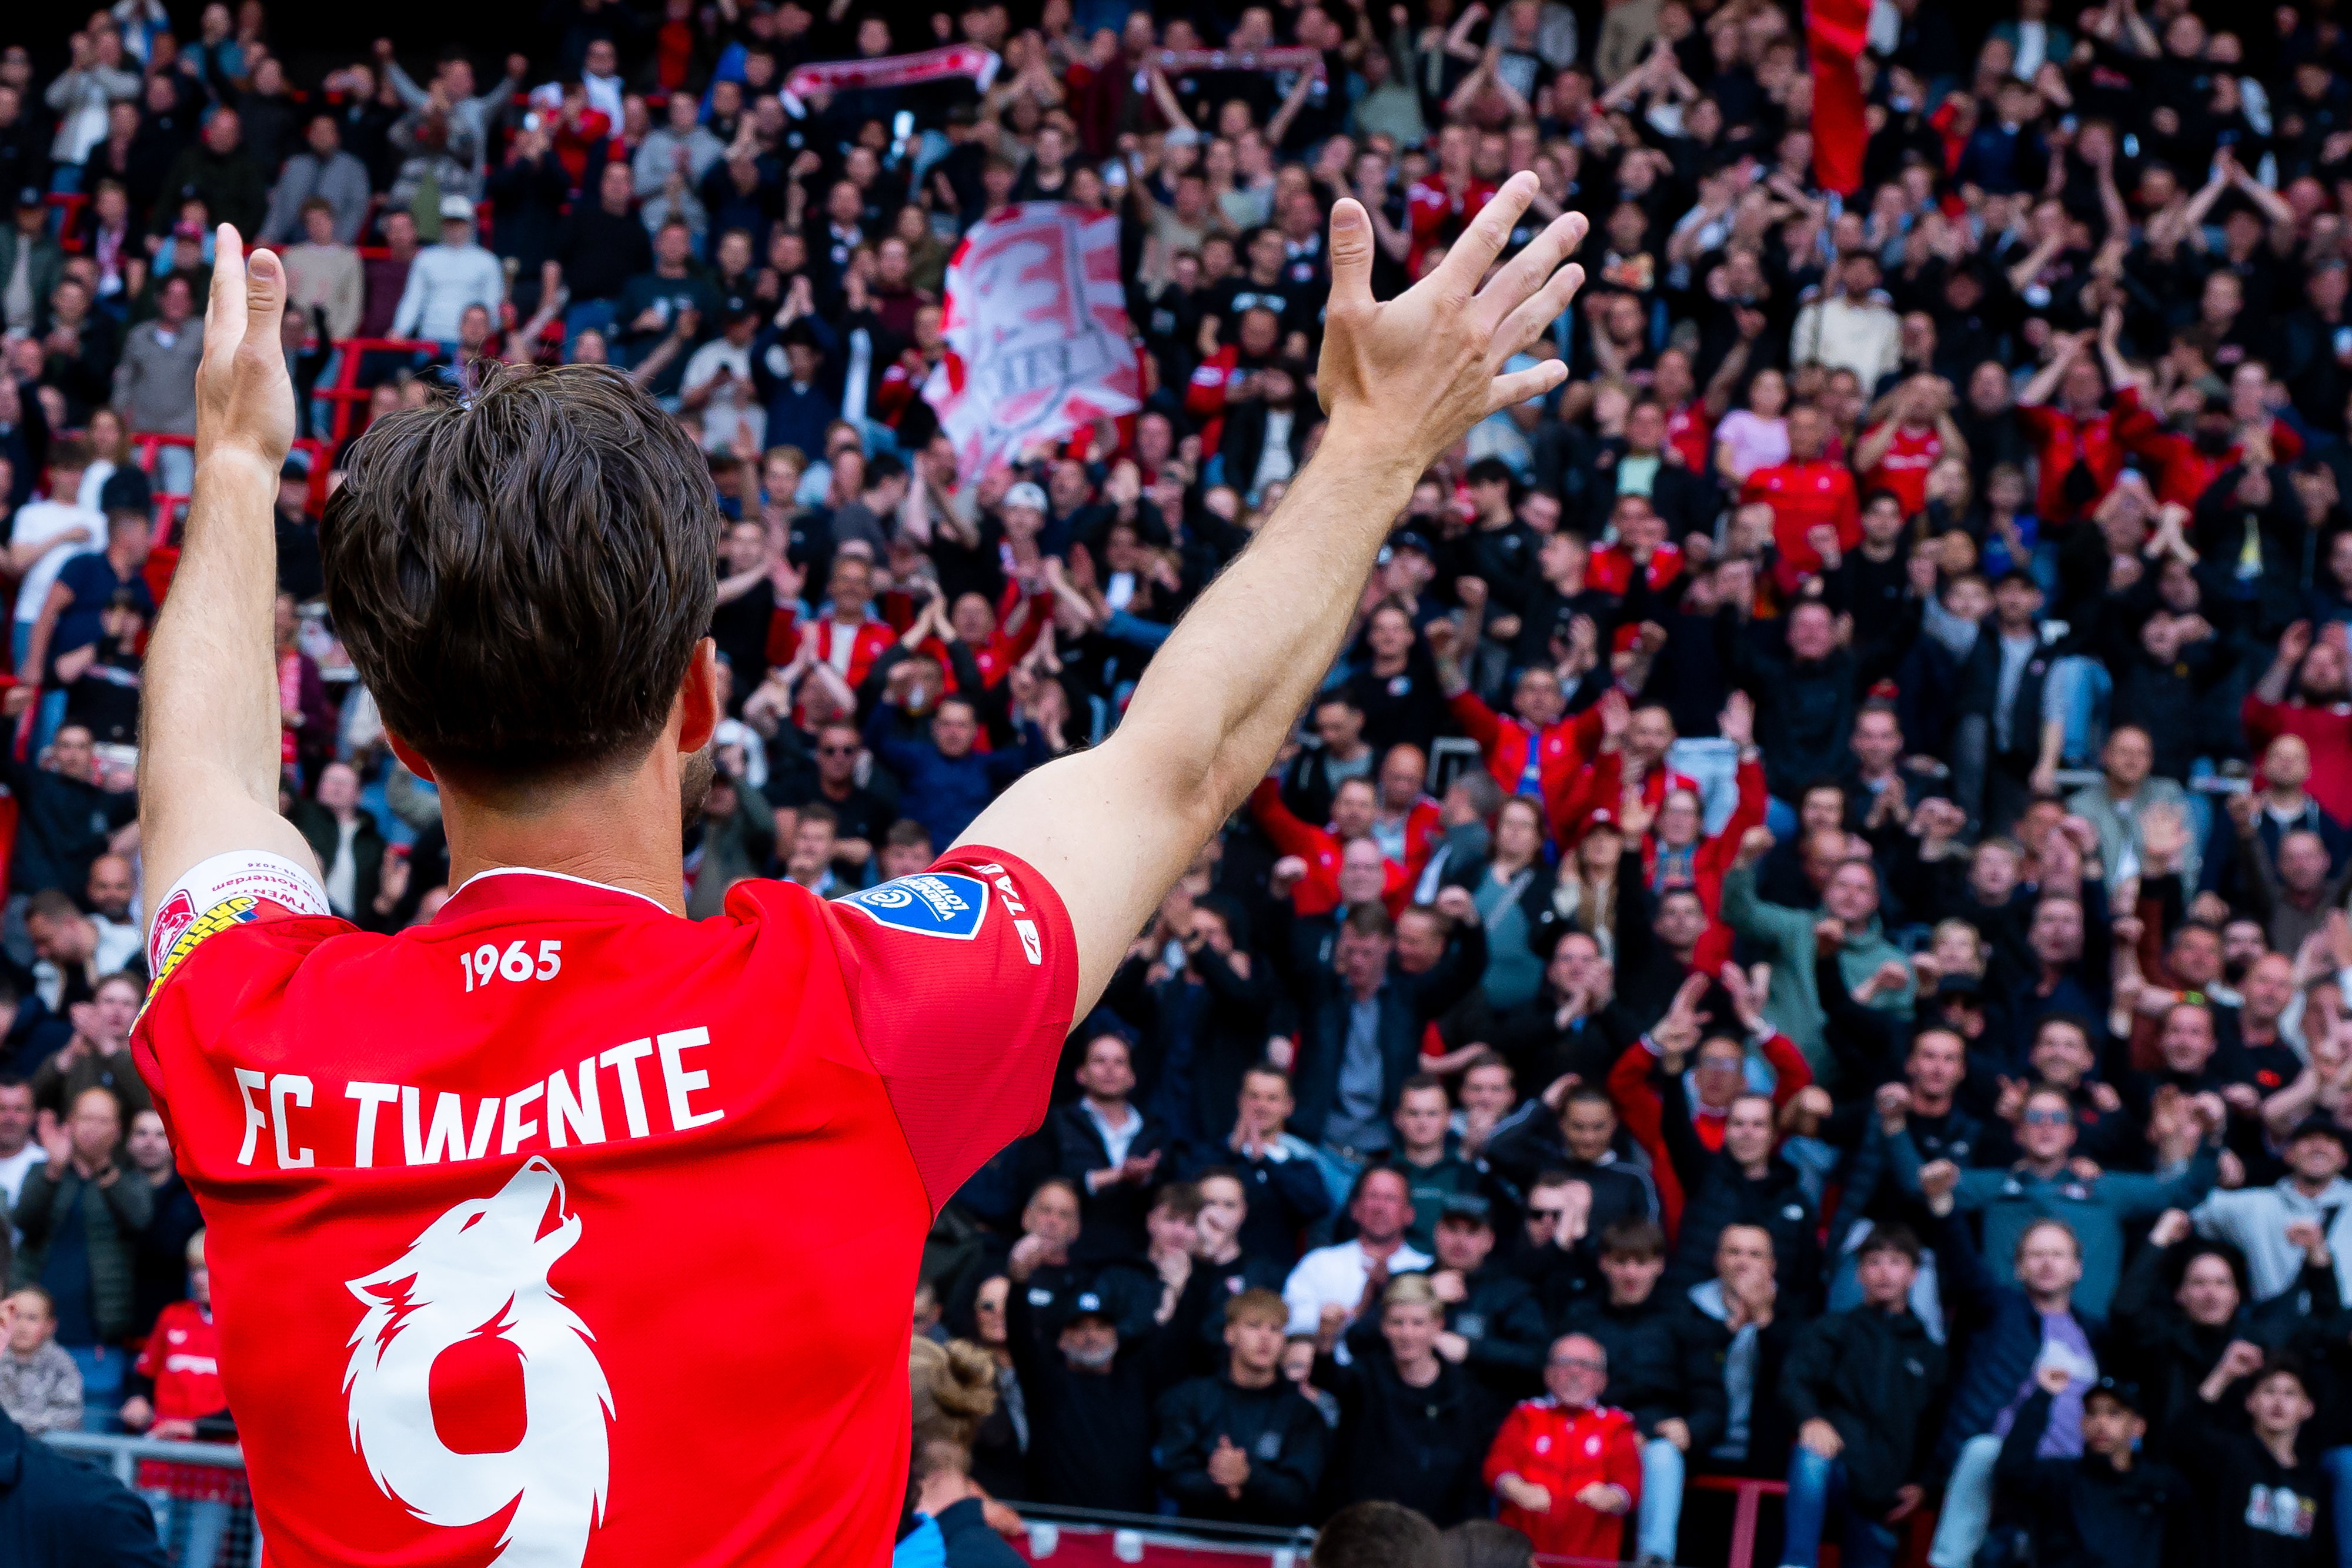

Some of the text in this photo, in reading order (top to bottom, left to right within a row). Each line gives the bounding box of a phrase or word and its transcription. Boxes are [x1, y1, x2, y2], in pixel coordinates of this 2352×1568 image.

[212, 875, 298, 892] Rotterdam
[460, 940, 562, 992] 1965
[234, 1025, 725, 1169] FC TWENTE
